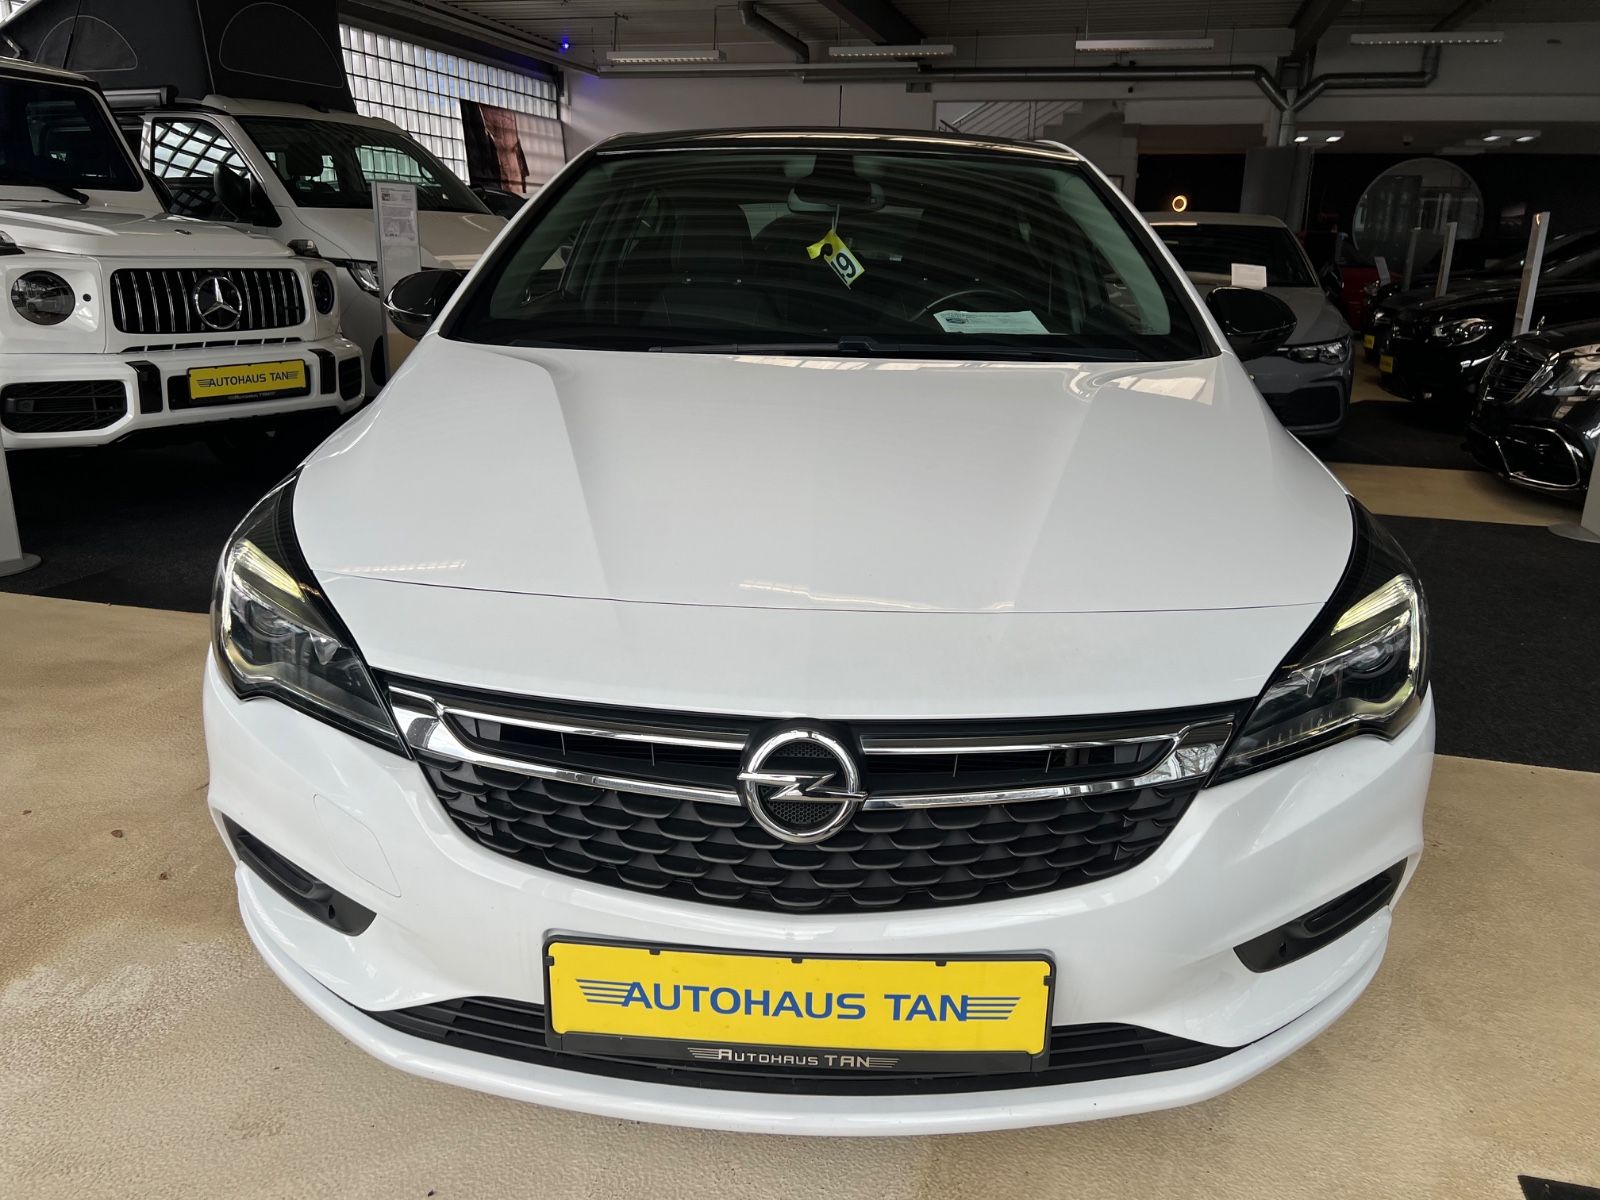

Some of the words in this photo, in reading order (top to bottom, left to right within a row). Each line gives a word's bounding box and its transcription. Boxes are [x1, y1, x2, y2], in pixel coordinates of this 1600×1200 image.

[208, 373, 267, 388] AUTOHAUS
[269, 370, 289, 381] TAN
[621, 981, 866, 1020] AUTOHAUS
[884, 994, 968, 1022] TAN
[718, 1049, 819, 1066] AUTOHAUS
[824, 1055, 870, 1068] TAN
